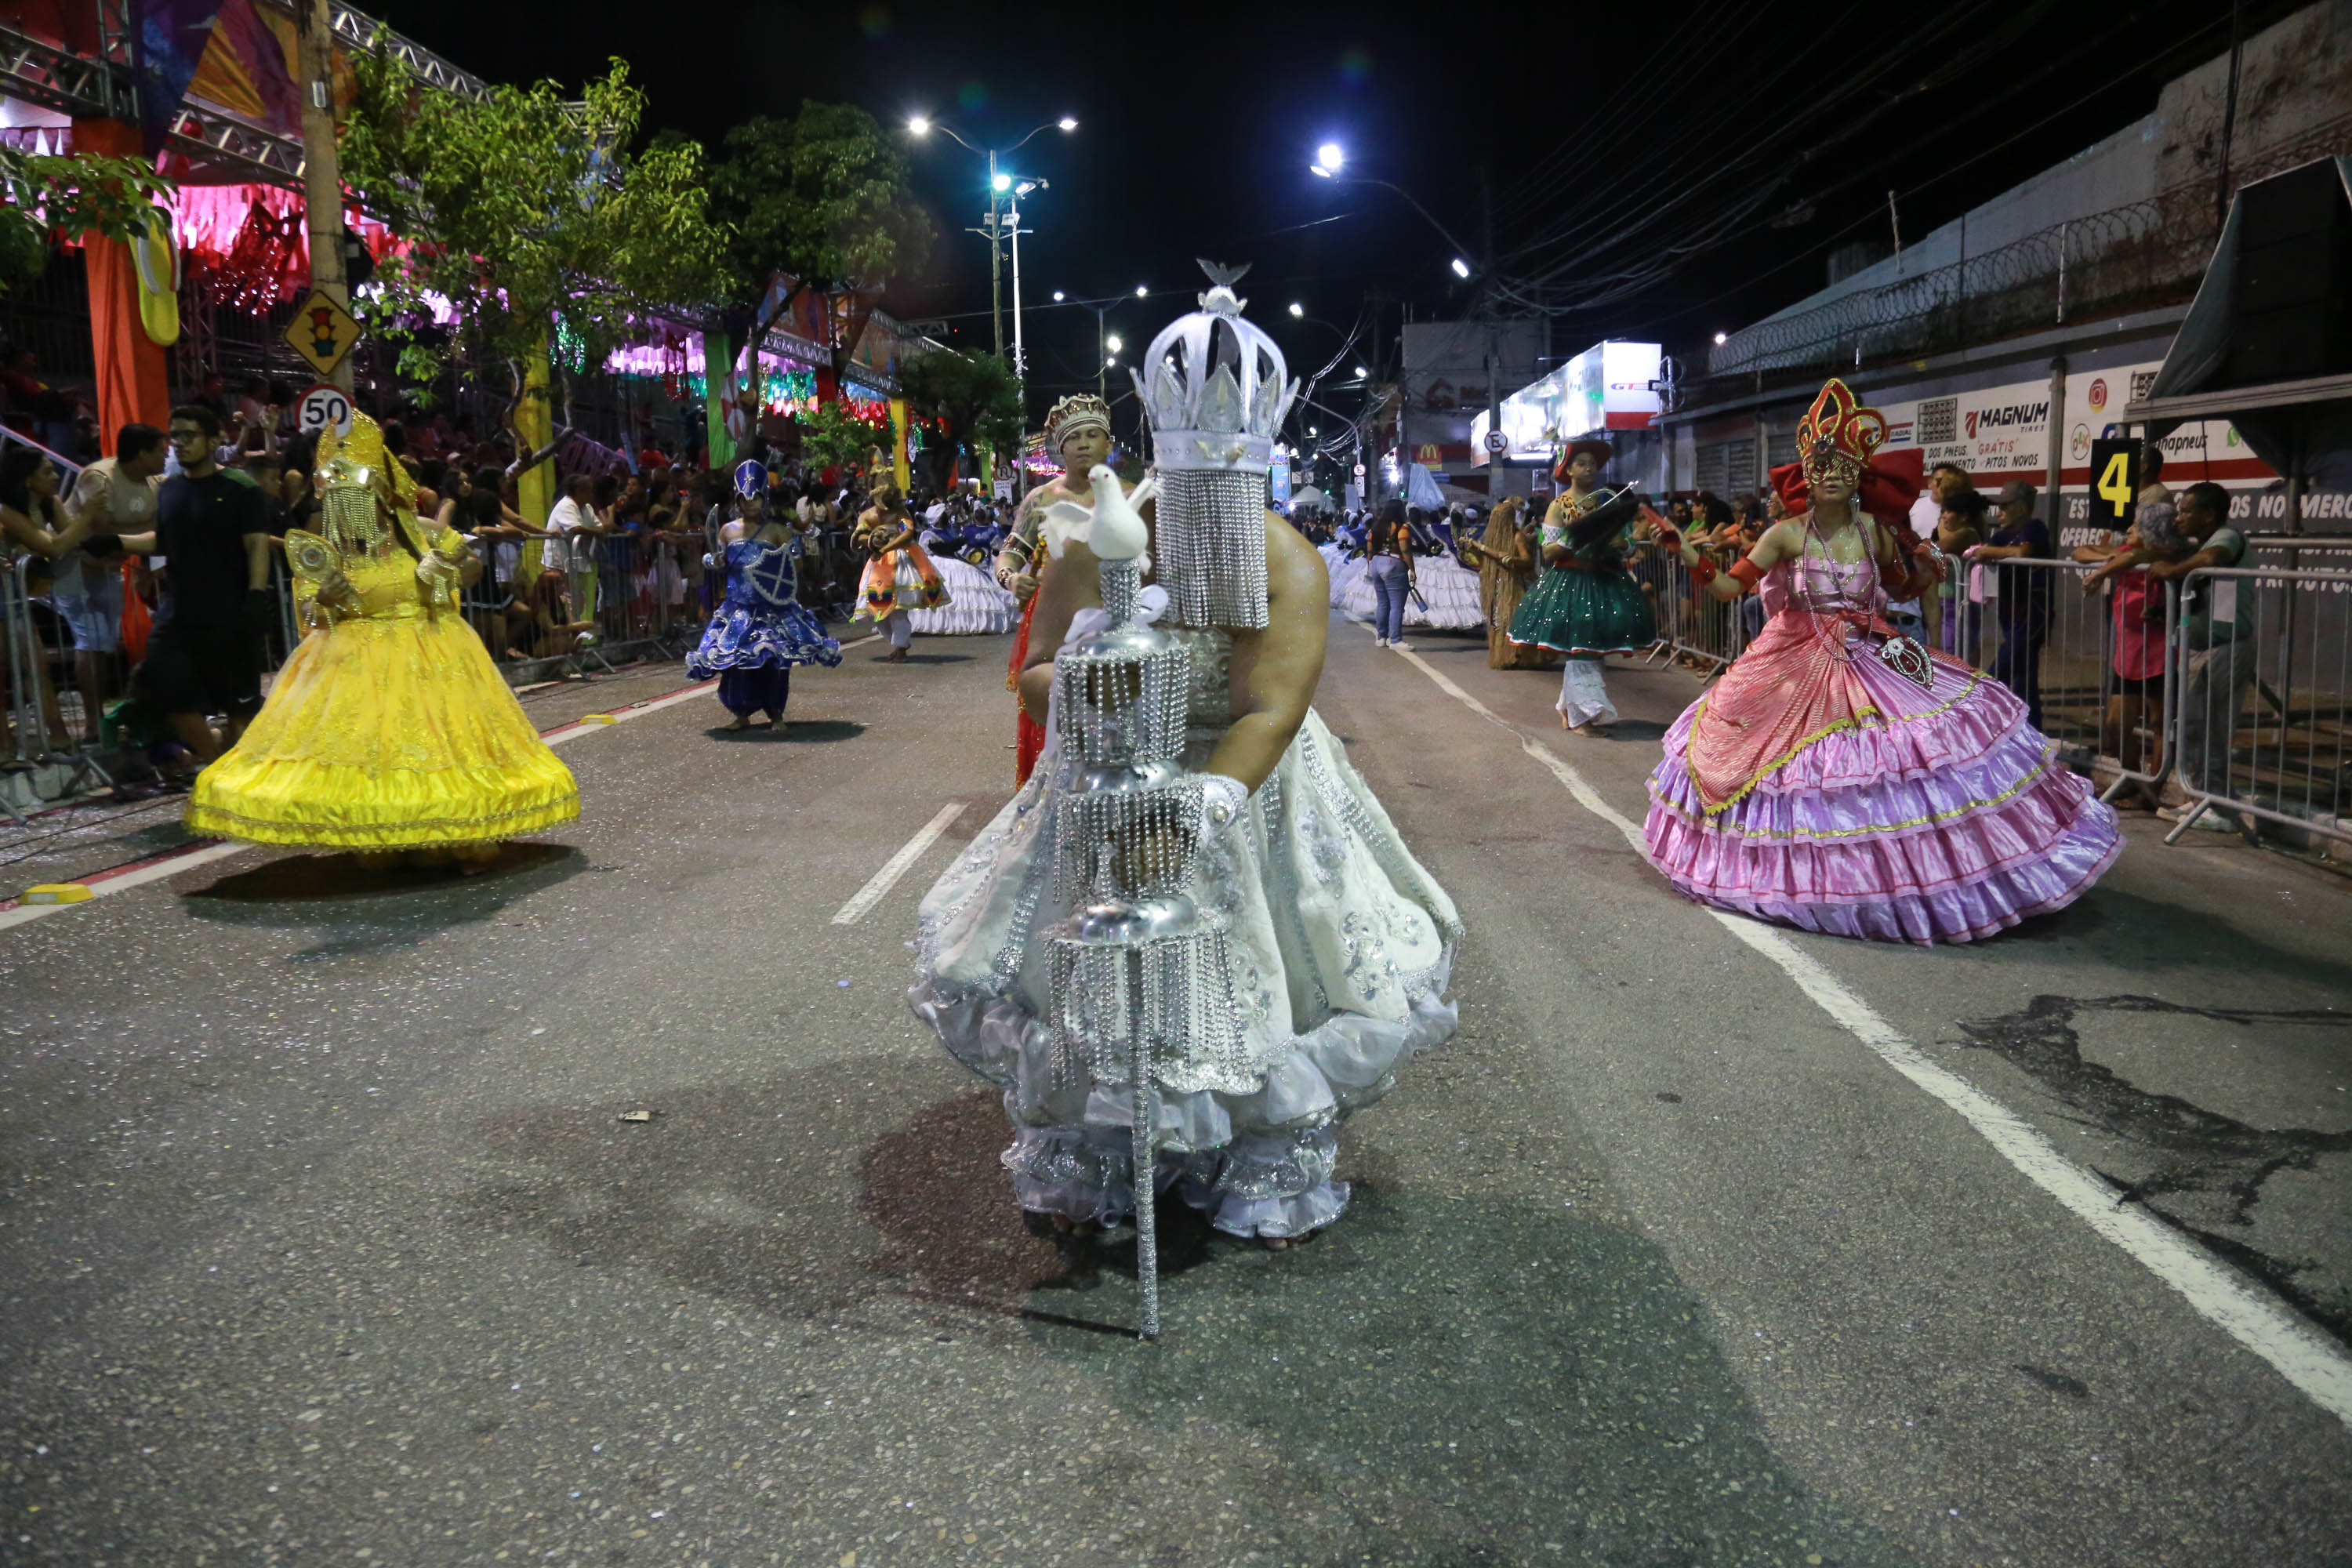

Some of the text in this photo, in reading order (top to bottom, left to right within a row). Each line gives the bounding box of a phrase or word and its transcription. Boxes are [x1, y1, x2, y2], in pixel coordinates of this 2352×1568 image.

[306, 398, 347, 425] 50
[1979, 401, 2049, 428] MAGNUM
[1929, 447, 1941, 459] DOS
[1985, 456, 2008, 469] PITOS
[2012, 454, 2038, 467] NOVOS
[2097, 452, 2132, 517] 4
[2257, 495, 2286, 519] NO
